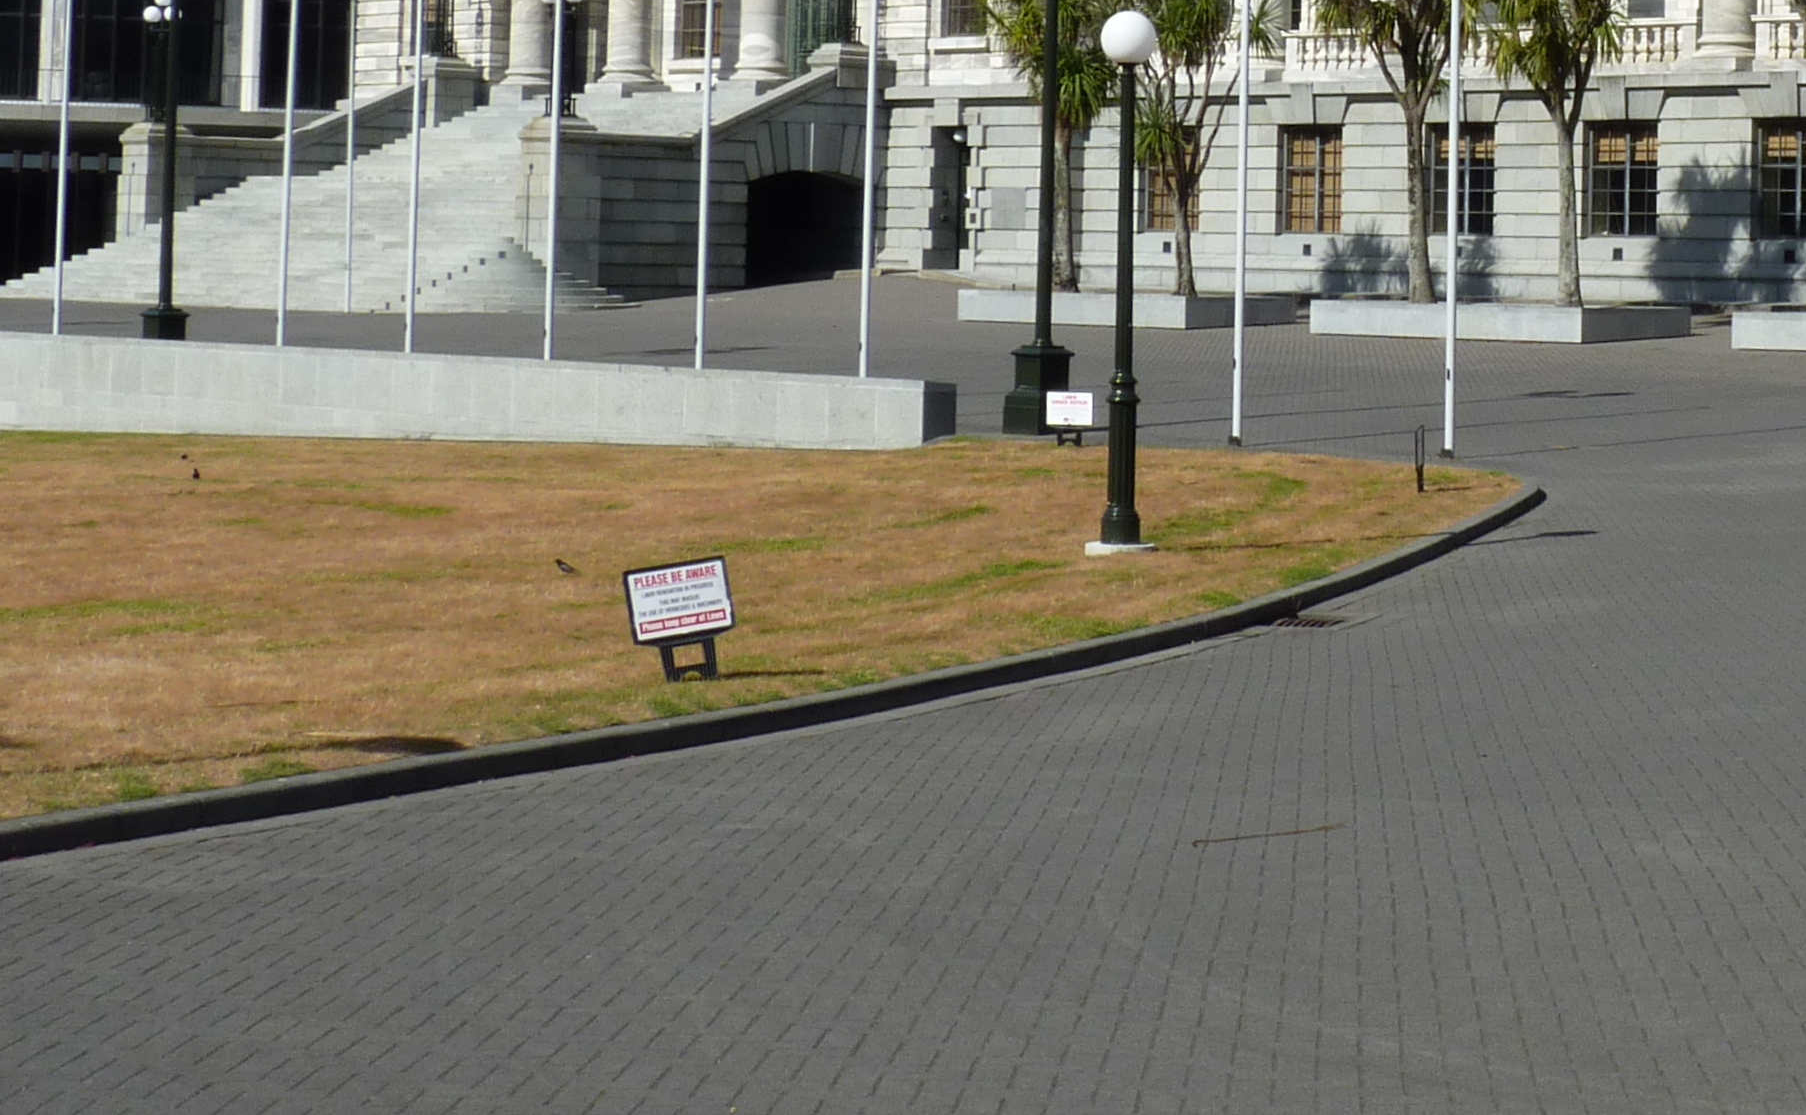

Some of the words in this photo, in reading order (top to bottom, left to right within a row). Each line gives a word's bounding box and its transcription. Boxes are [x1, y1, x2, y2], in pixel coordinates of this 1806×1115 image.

[633, 572, 669, 589] PLEASE
[671, 570, 683, 582] BE
[685, 564, 717, 580] AWARE
